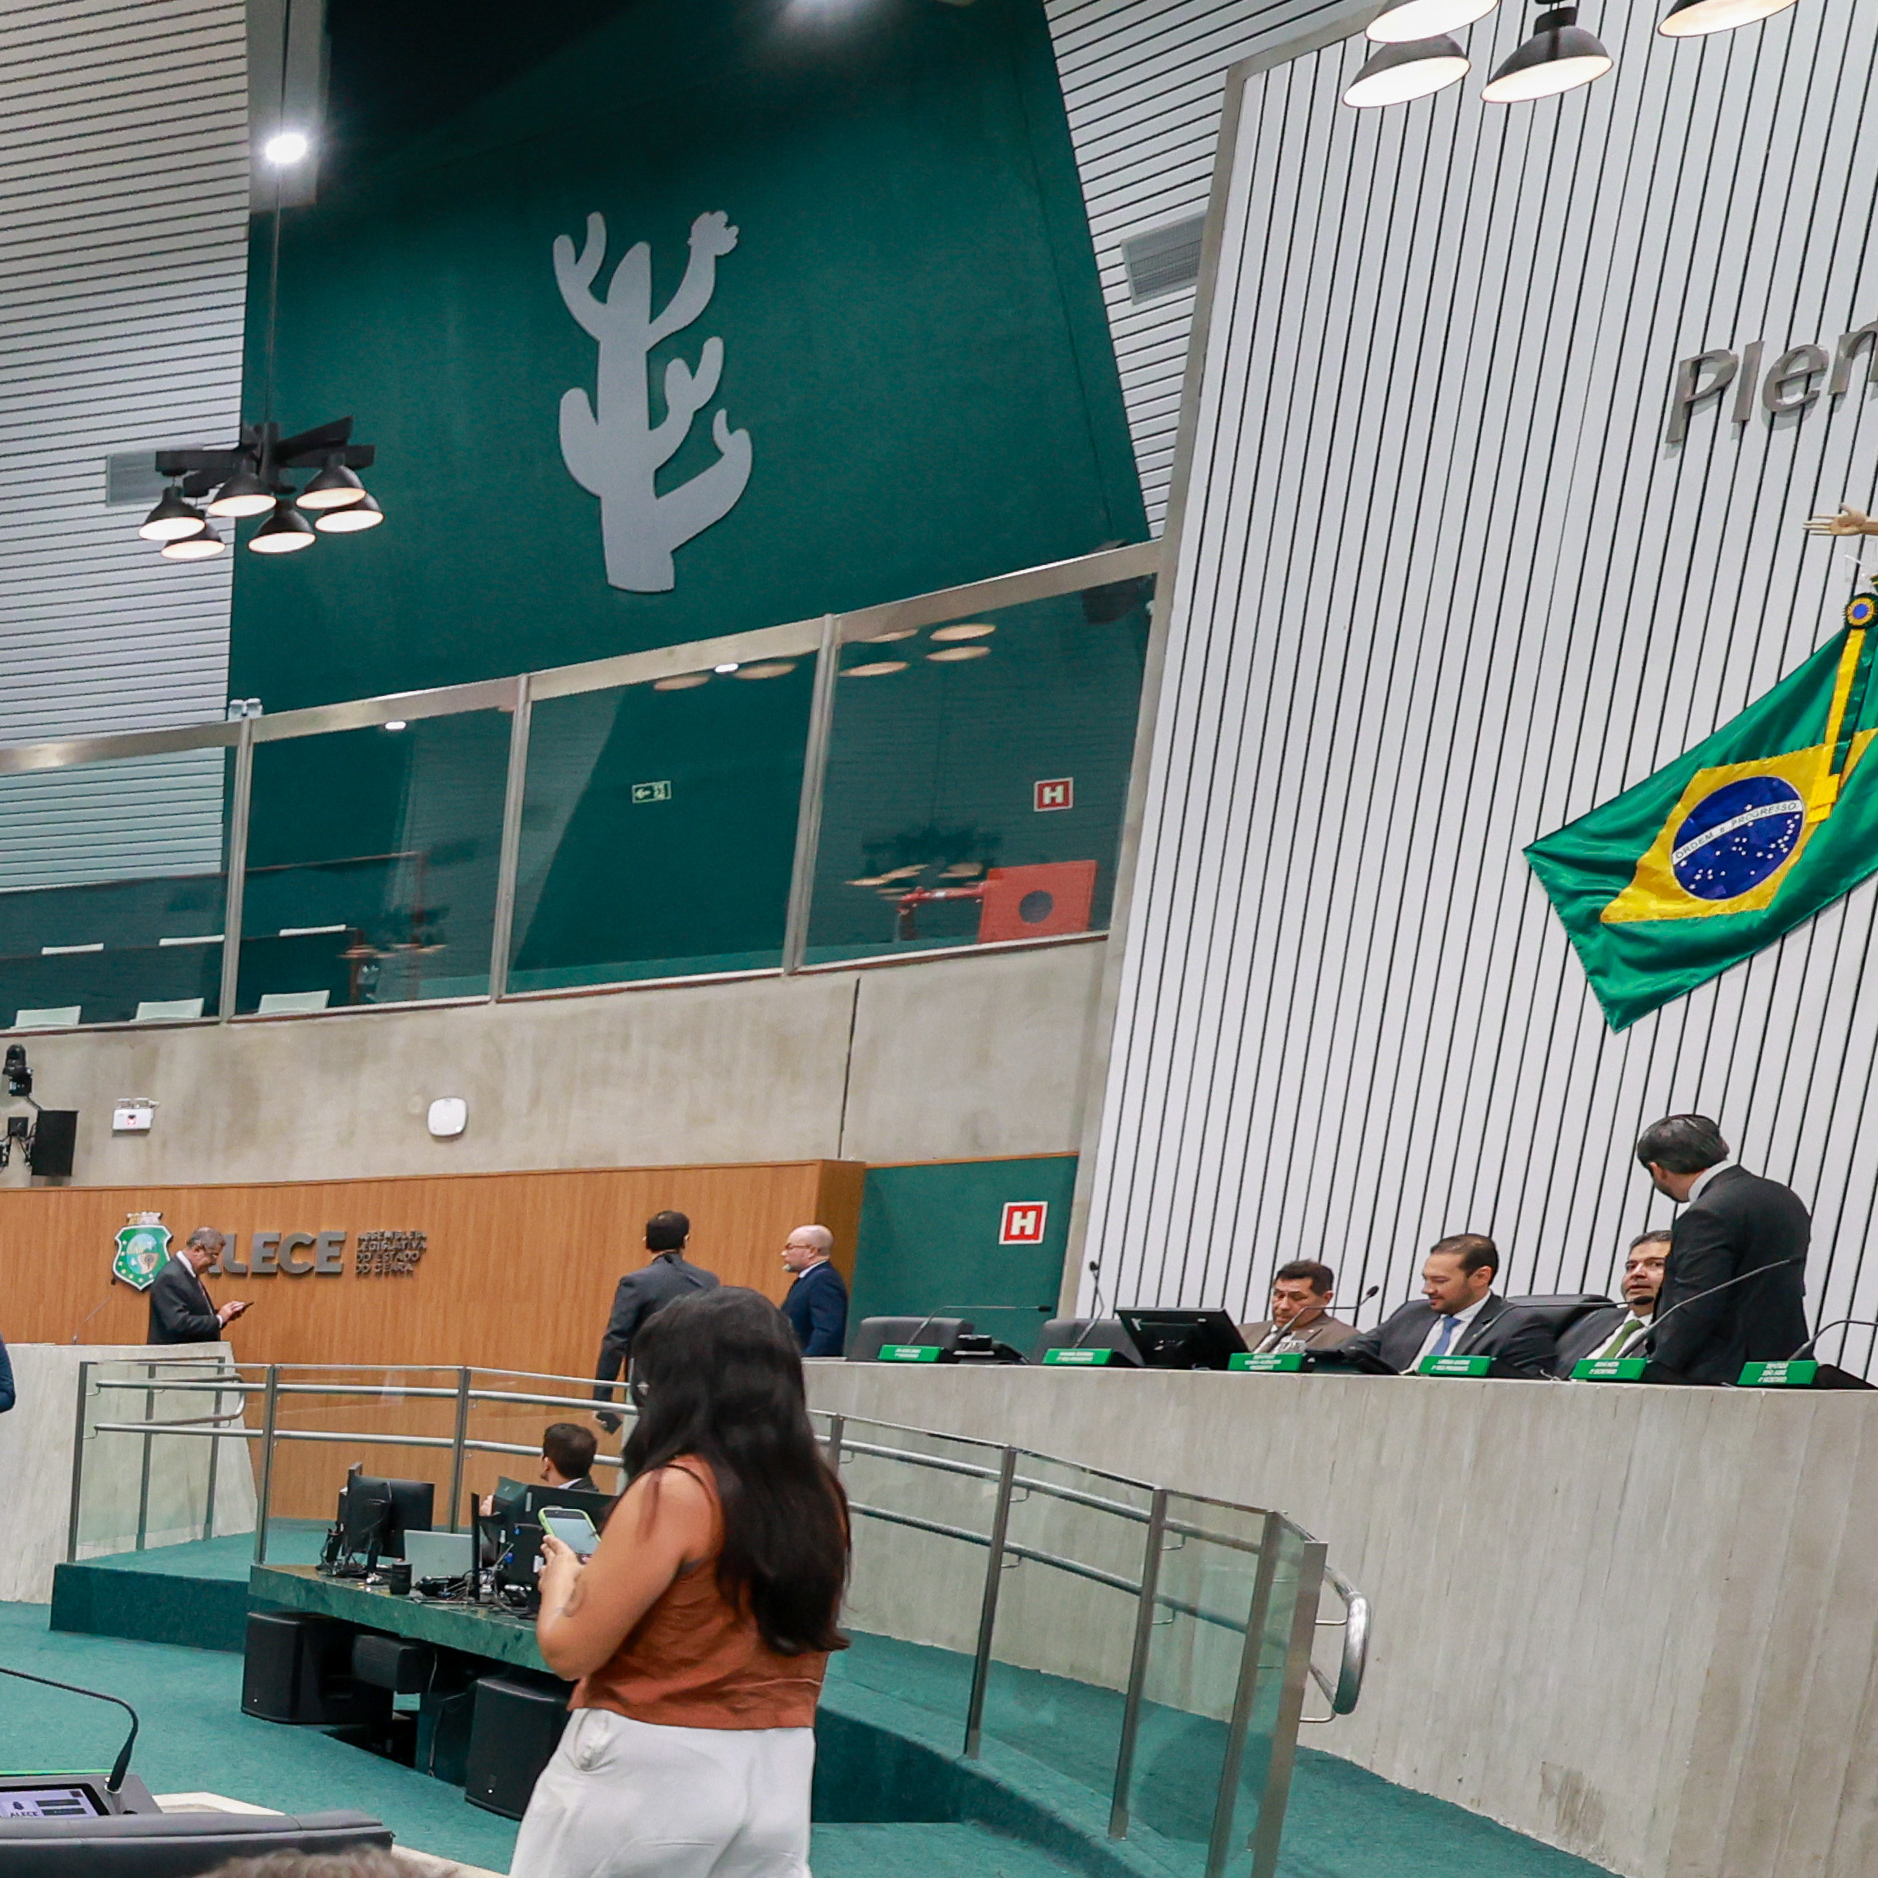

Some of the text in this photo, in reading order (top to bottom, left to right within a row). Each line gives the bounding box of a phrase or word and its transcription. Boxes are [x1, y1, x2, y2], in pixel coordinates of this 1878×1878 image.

[1044, 786, 1064, 804] H
[1675, 832, 1714, 859] ORDEM
[1731, 802, 1797, 827] PROGRESSO
[1010, 1211, 1037, 1235] H
[207, 1231, 346, 1275] LECE
